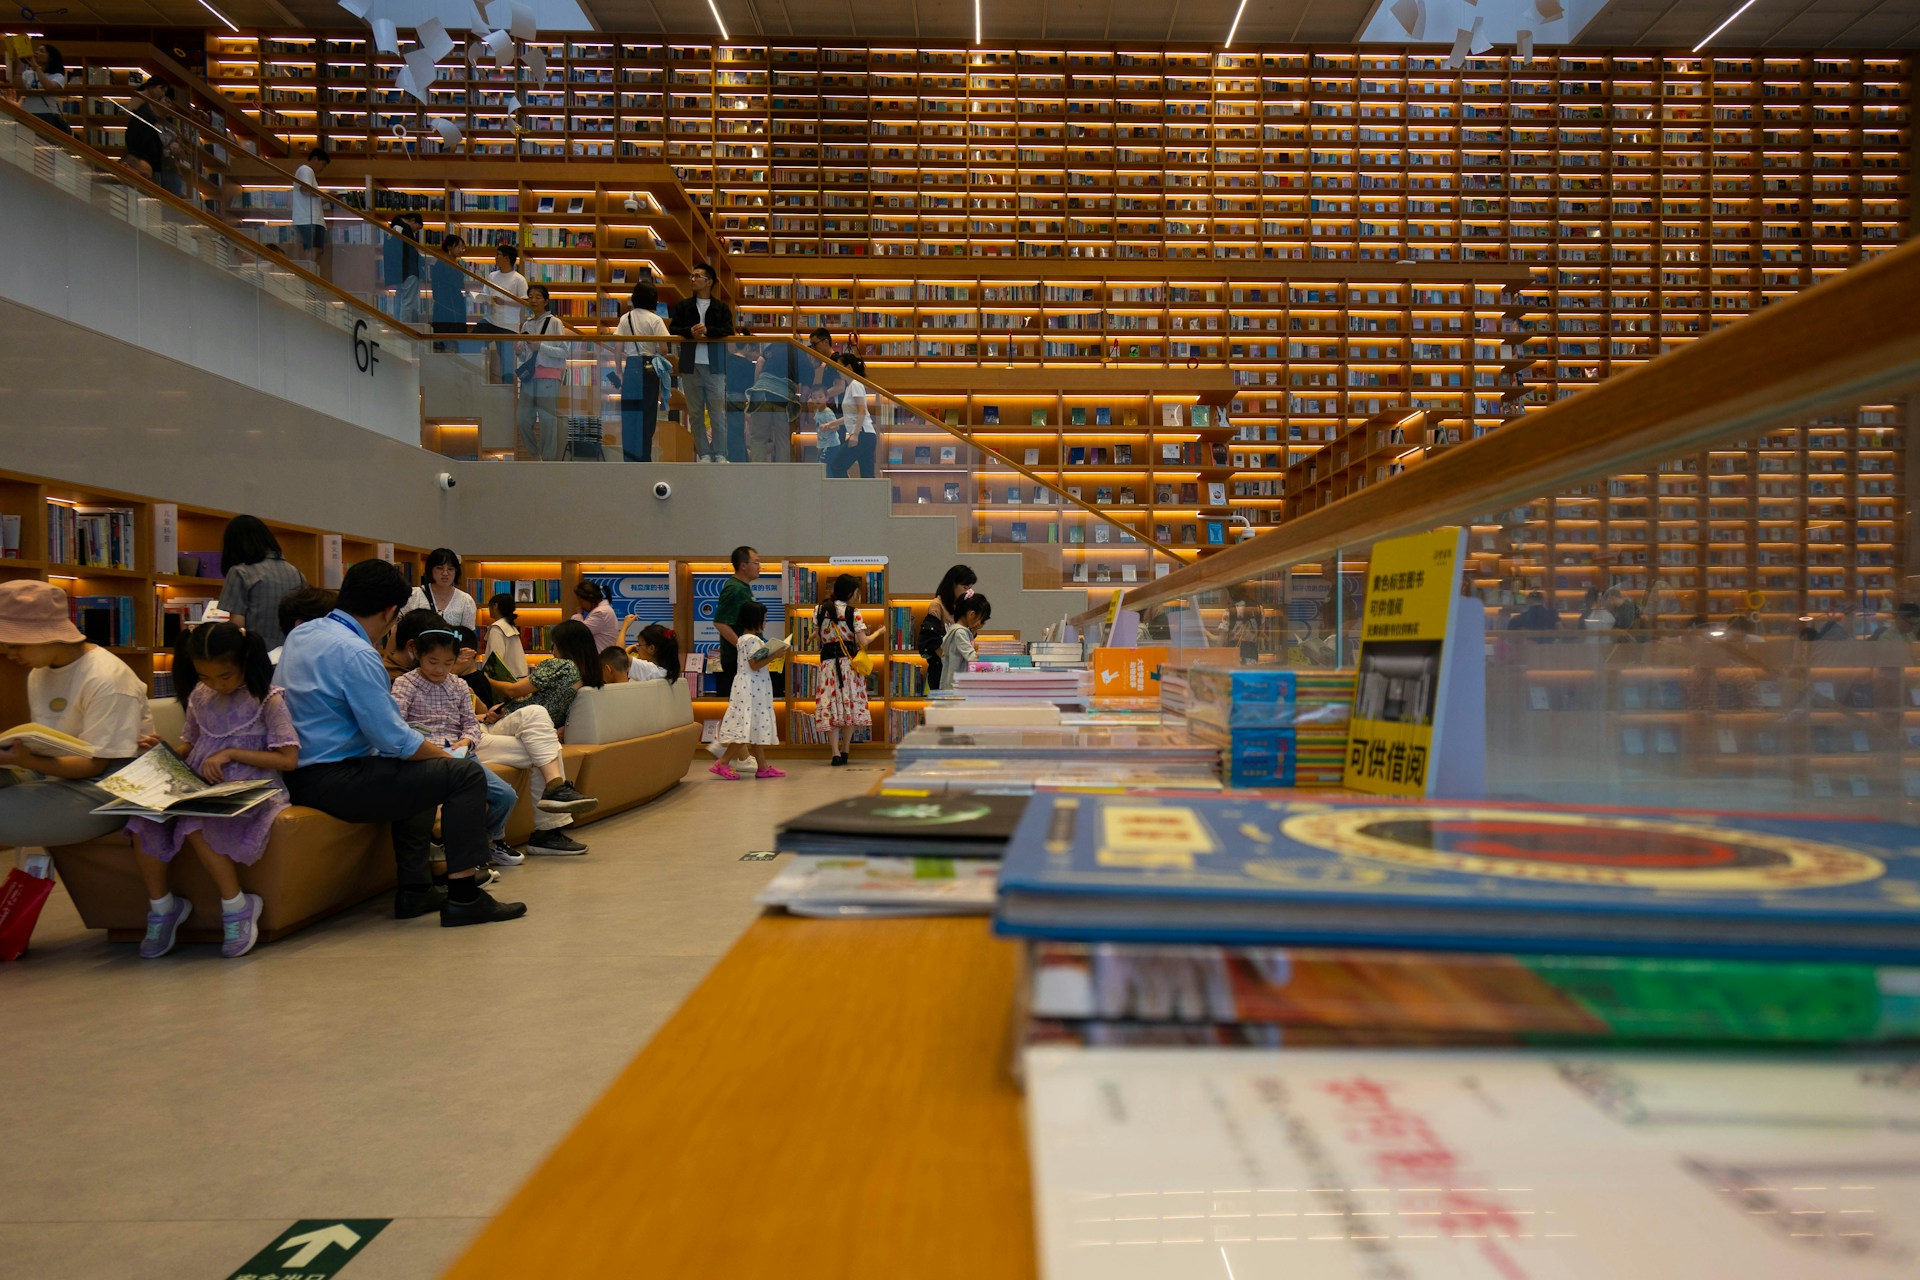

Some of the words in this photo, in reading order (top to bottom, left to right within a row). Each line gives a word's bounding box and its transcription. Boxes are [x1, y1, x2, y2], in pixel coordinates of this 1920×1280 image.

[354, 319, 380, 377] 6F
[751, 584, 778, 592] 度的书架
[1373, 570, 1425, 593] 黄色标签图书
[1370, 598, 1404, 617] 可供借阅
[1350, 738, 1428, 788] 可供借阅
